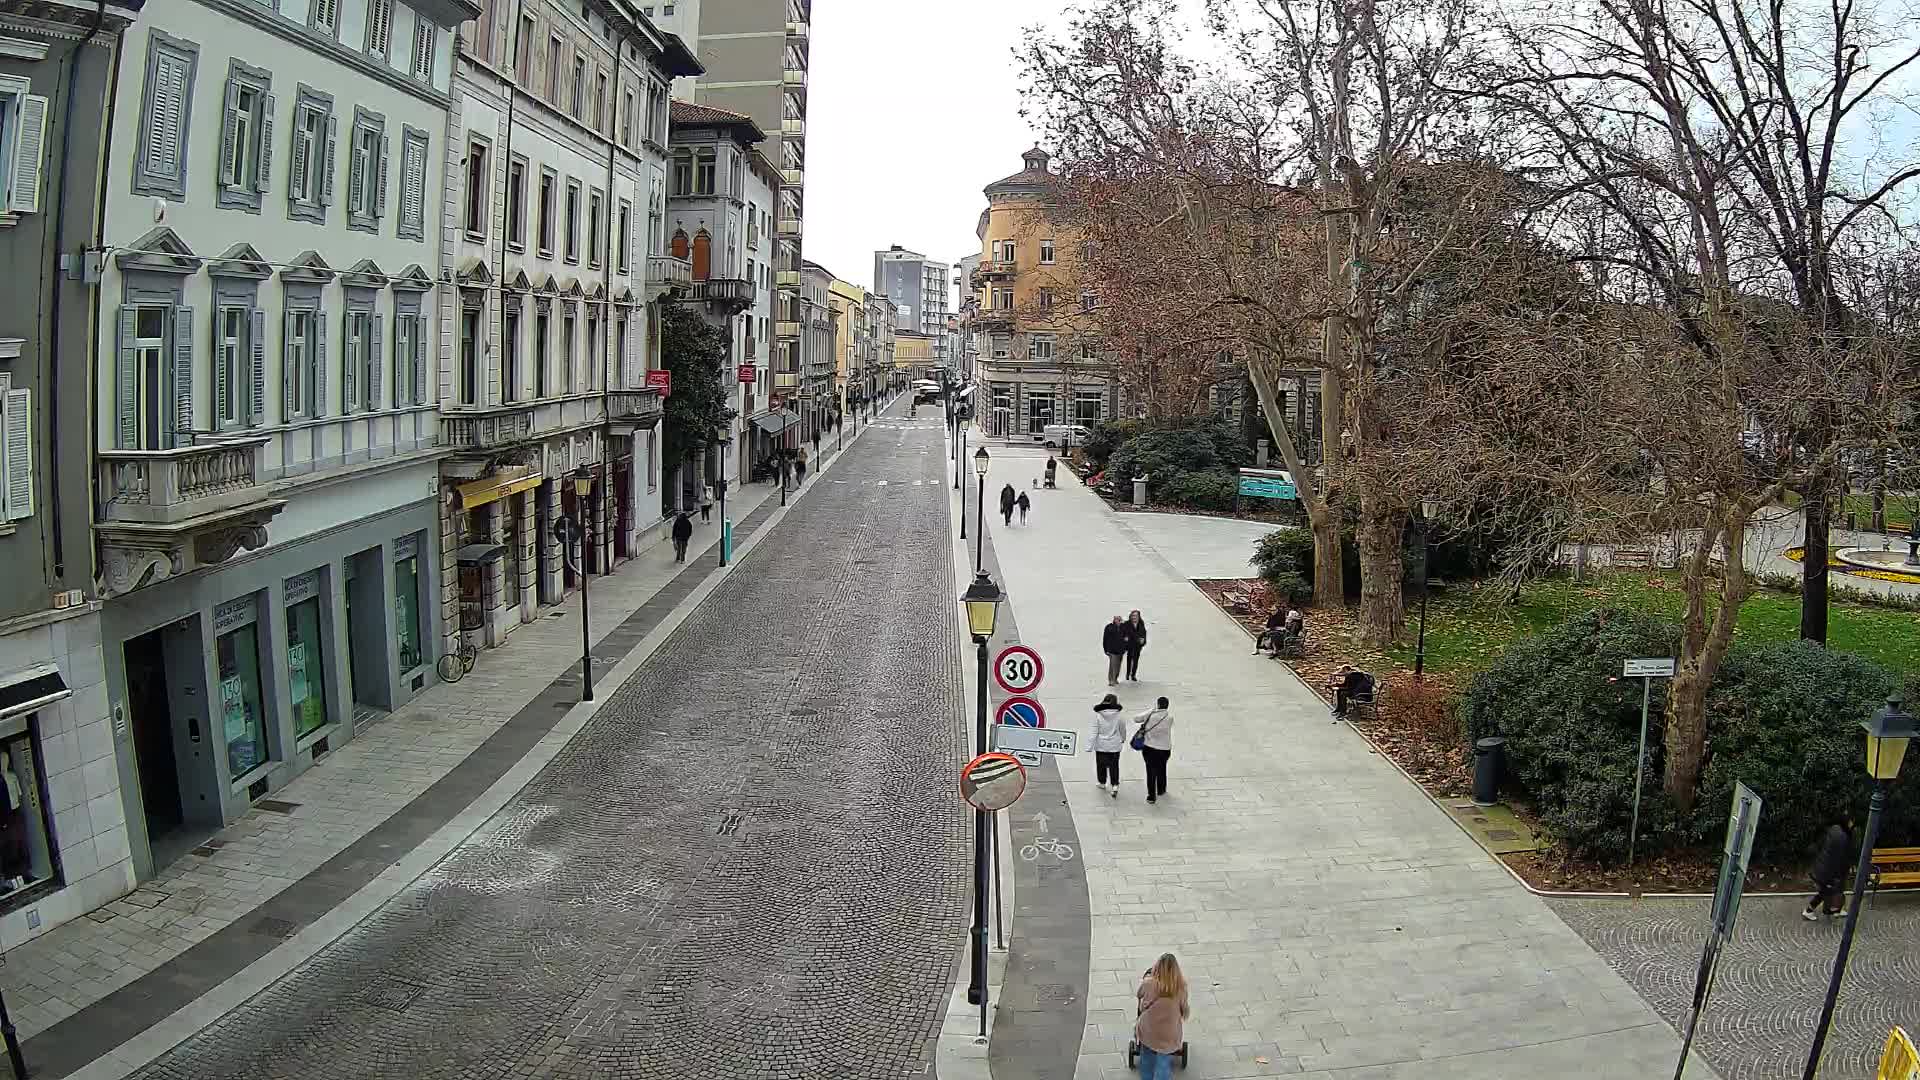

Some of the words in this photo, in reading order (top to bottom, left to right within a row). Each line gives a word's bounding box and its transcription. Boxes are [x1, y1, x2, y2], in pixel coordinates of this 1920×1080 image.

[289, 646, 304, 666] 130
[1006, 659, 1033, 681] 30
[223, 679, 240, 701] 130
[1039, 739, 1070, 750] Dante
